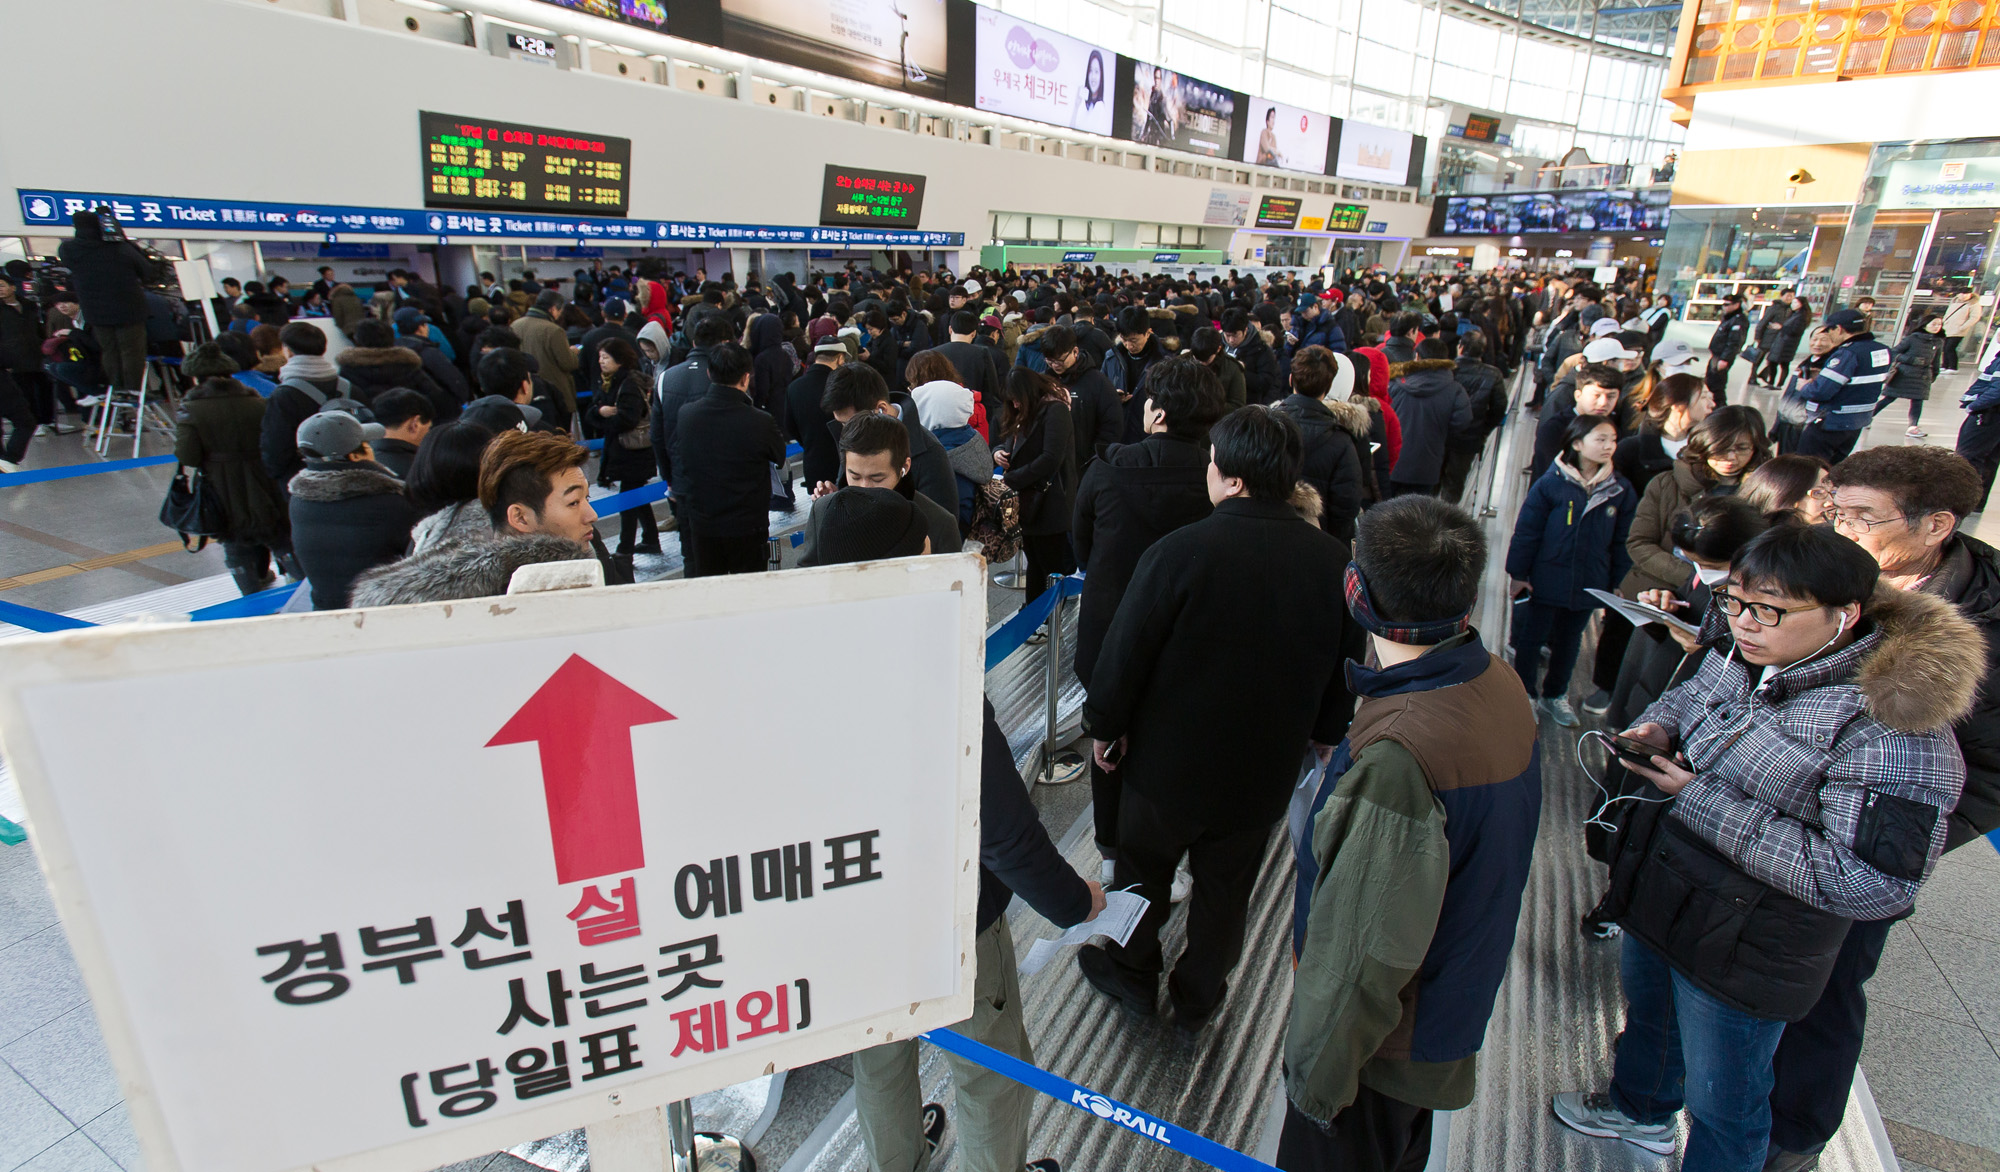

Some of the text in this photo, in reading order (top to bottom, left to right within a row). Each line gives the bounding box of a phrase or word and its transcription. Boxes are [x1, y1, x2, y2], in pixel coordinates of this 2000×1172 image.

[516, 35, 546, 56] 9:28
[1024, 73, 1069, 105] 체크카드
[835, 175, 901, 193] 오늘 승차권 사는 곳
[140, 202, 163, 222] 곳
[166, 205, 217, 222] Ticket
[446, 215, 487, 232] 표사는
[489, 217, 502, 233] 곳
[504, 219, 533, 232] Ticket
[670, 224, 697, 238] 표사는
[698, 225, 706, 239] 곳
[707, 227, 727, 238] Ticket
[821, 230, 840, 241] 표사는
[841, 230, 848, 241] 곳
[848, 232, 863, 240] Ticket
[255, 829, 883, 1006] 경부선 설 예매표
[1071, 1089, 1171, 1144] KORAIL
